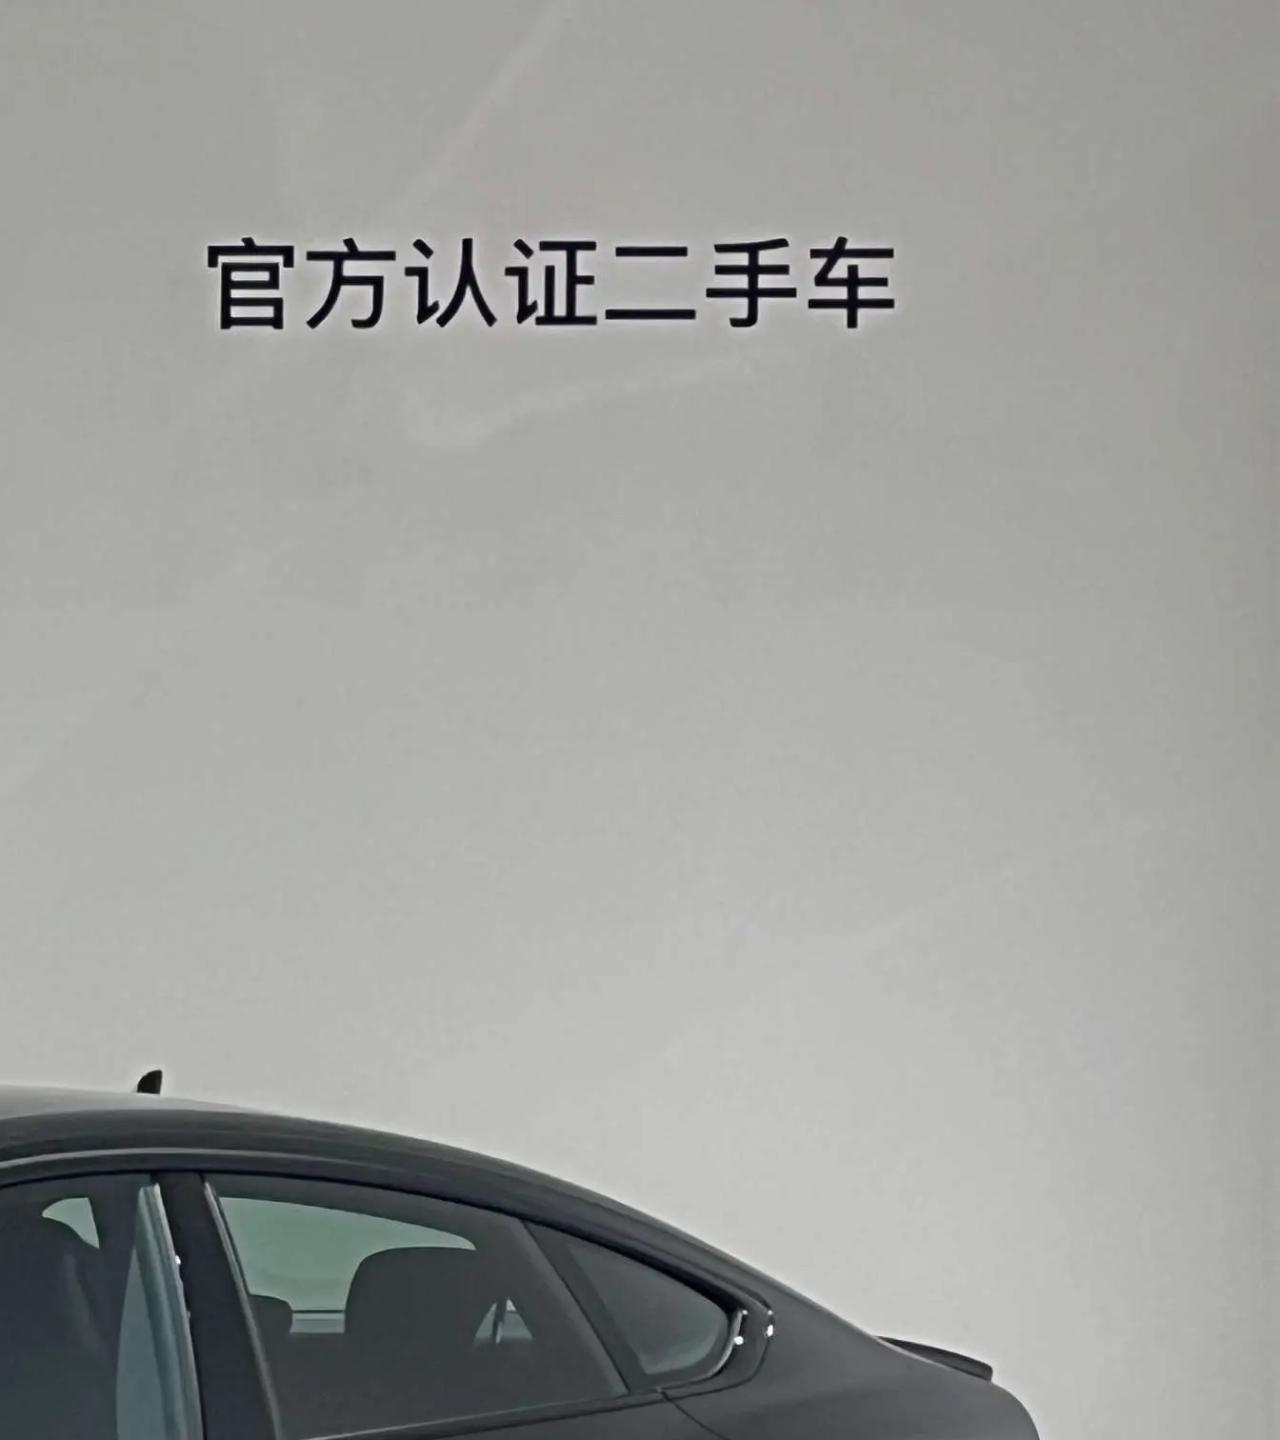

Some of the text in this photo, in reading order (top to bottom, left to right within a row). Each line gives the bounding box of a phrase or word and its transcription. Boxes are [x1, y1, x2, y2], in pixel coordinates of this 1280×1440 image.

[206, 236, 895, 329] 官方认证二手车
